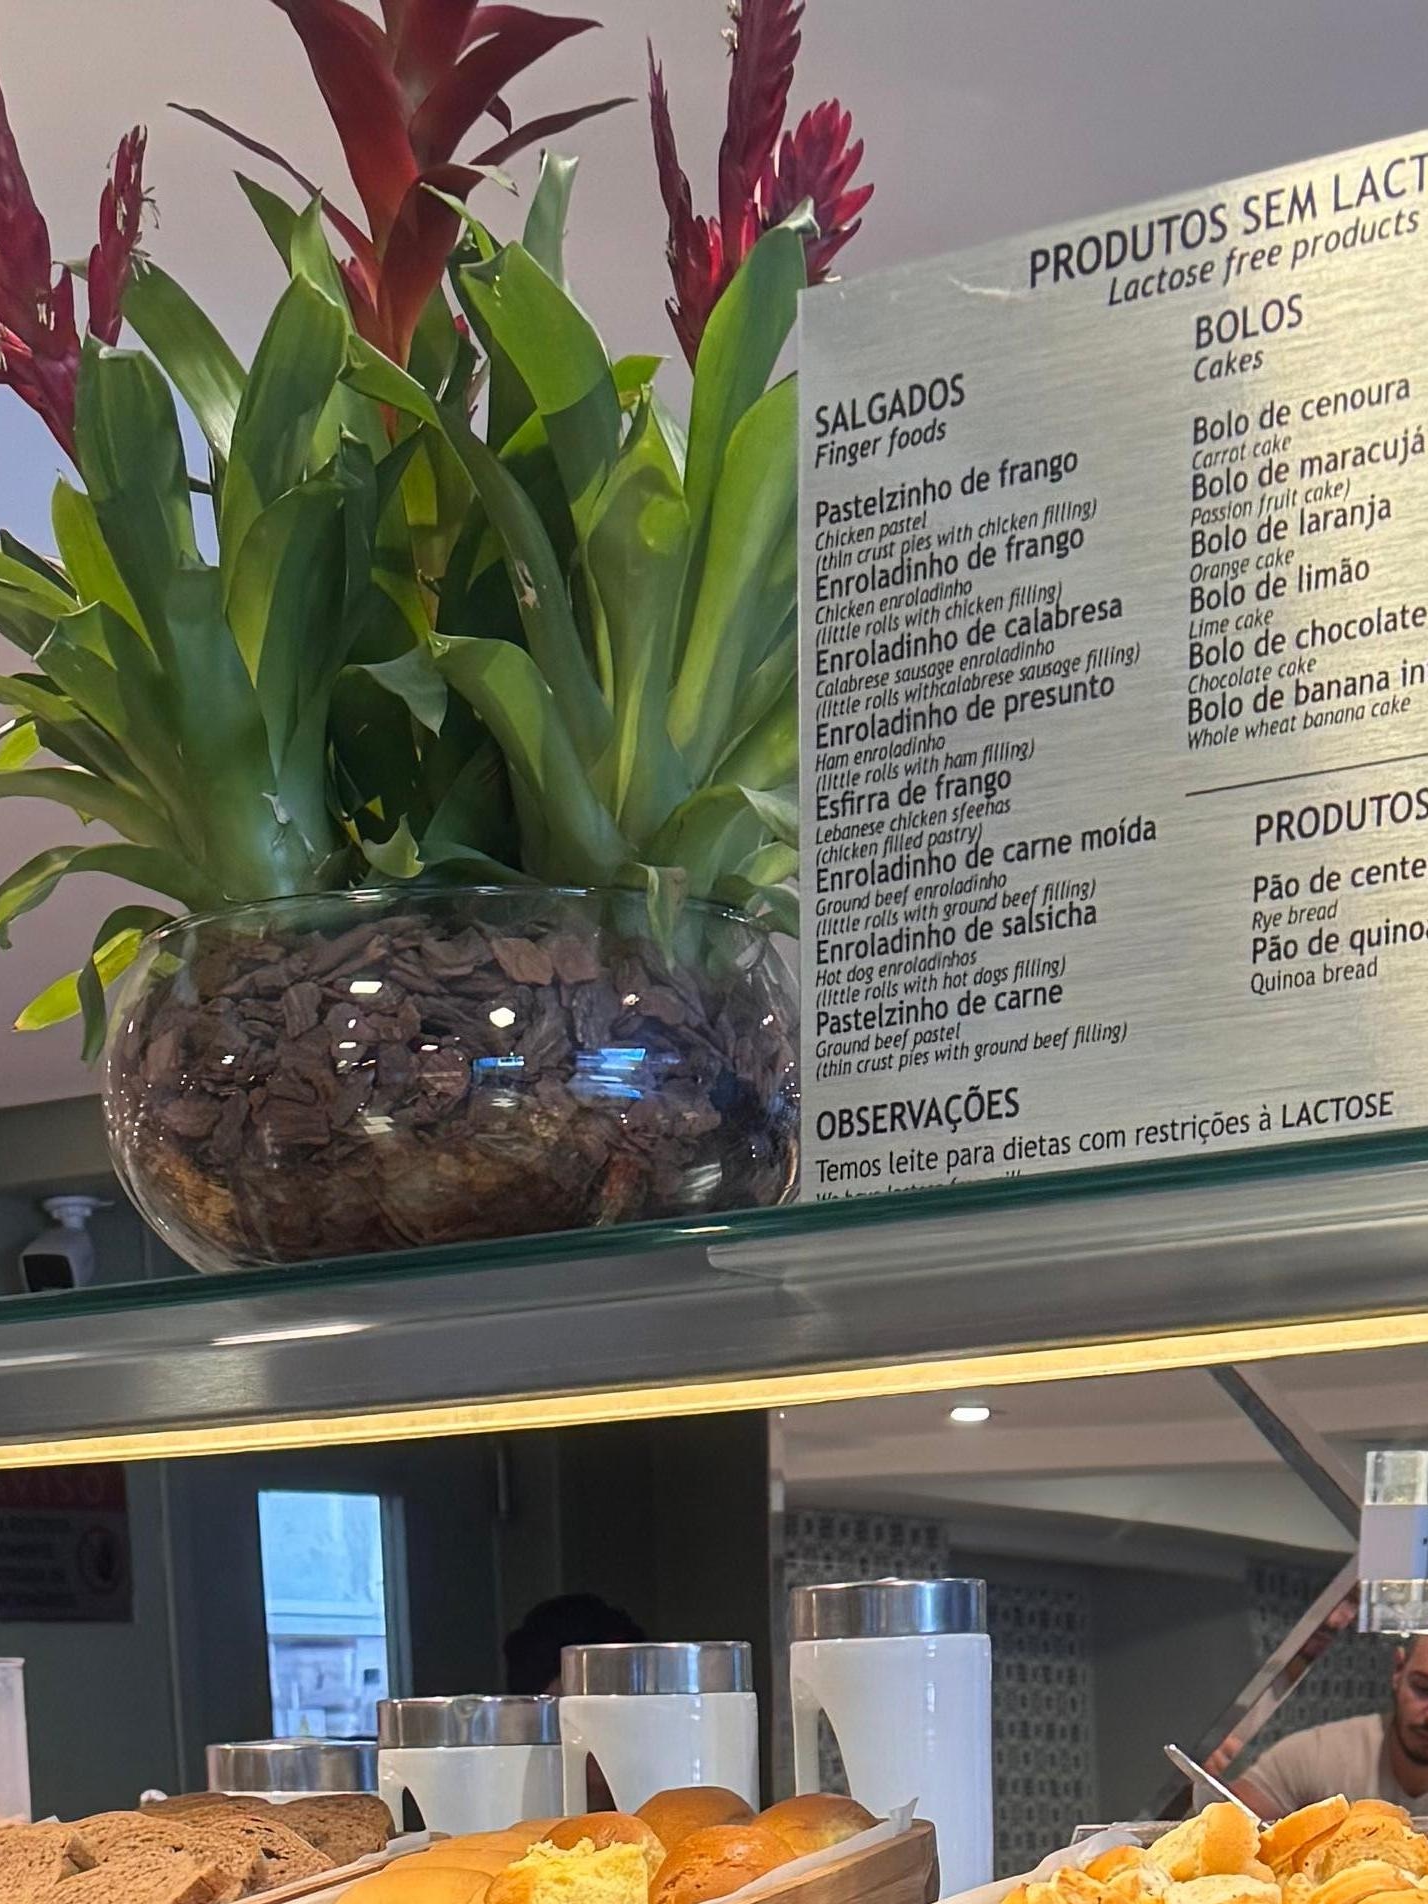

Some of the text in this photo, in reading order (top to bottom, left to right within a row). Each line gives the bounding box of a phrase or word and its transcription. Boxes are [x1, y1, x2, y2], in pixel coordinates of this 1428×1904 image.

[1029, 203, 1228, 289] PRODUTOS
[1241, 181, 1317, 236] SEM
[1106, 208, 1420, 307] Lactose free products
[1194, 292, 1303, 350] BOLOS
[1192, 349, 1264, 383] Cakes
[814, 372, 965, 439] SALGADOS
[1192, 377, 1410, 446] Bolo de cenoura
[813, 416, 947, 469] Finger foods
[1191, 433, 1292, 471] Carrot cake
[1191, 425, 1425, 502] Bolo de maracujá
[815, 450, 1078, 528] Pastelzinho de frango
[814, 509, 927, 552] Chicken pastel
[815, 496, 1097, 579] (thin crust pies with chicken filling)
[1187, 692, 1243, 726] Bolo
[1252, 685, 1284, 713] de
[1293, 669, 1390, 707] banana
[1187, 694, 1411, 750] Whole wheat banana cake
[815, 769, 1012, 822] Esfirra de frango
[816, 814, 1157, 894] Enroladinho de carne moída
[814, 949, 977, 989] Hot dog enroladinhos
[814, 1089, 1394, 1183] Temos leite para dietas com restrições à LACTOSE
[815, 1084, 1019, 1141] OBSERVAÇÕES
